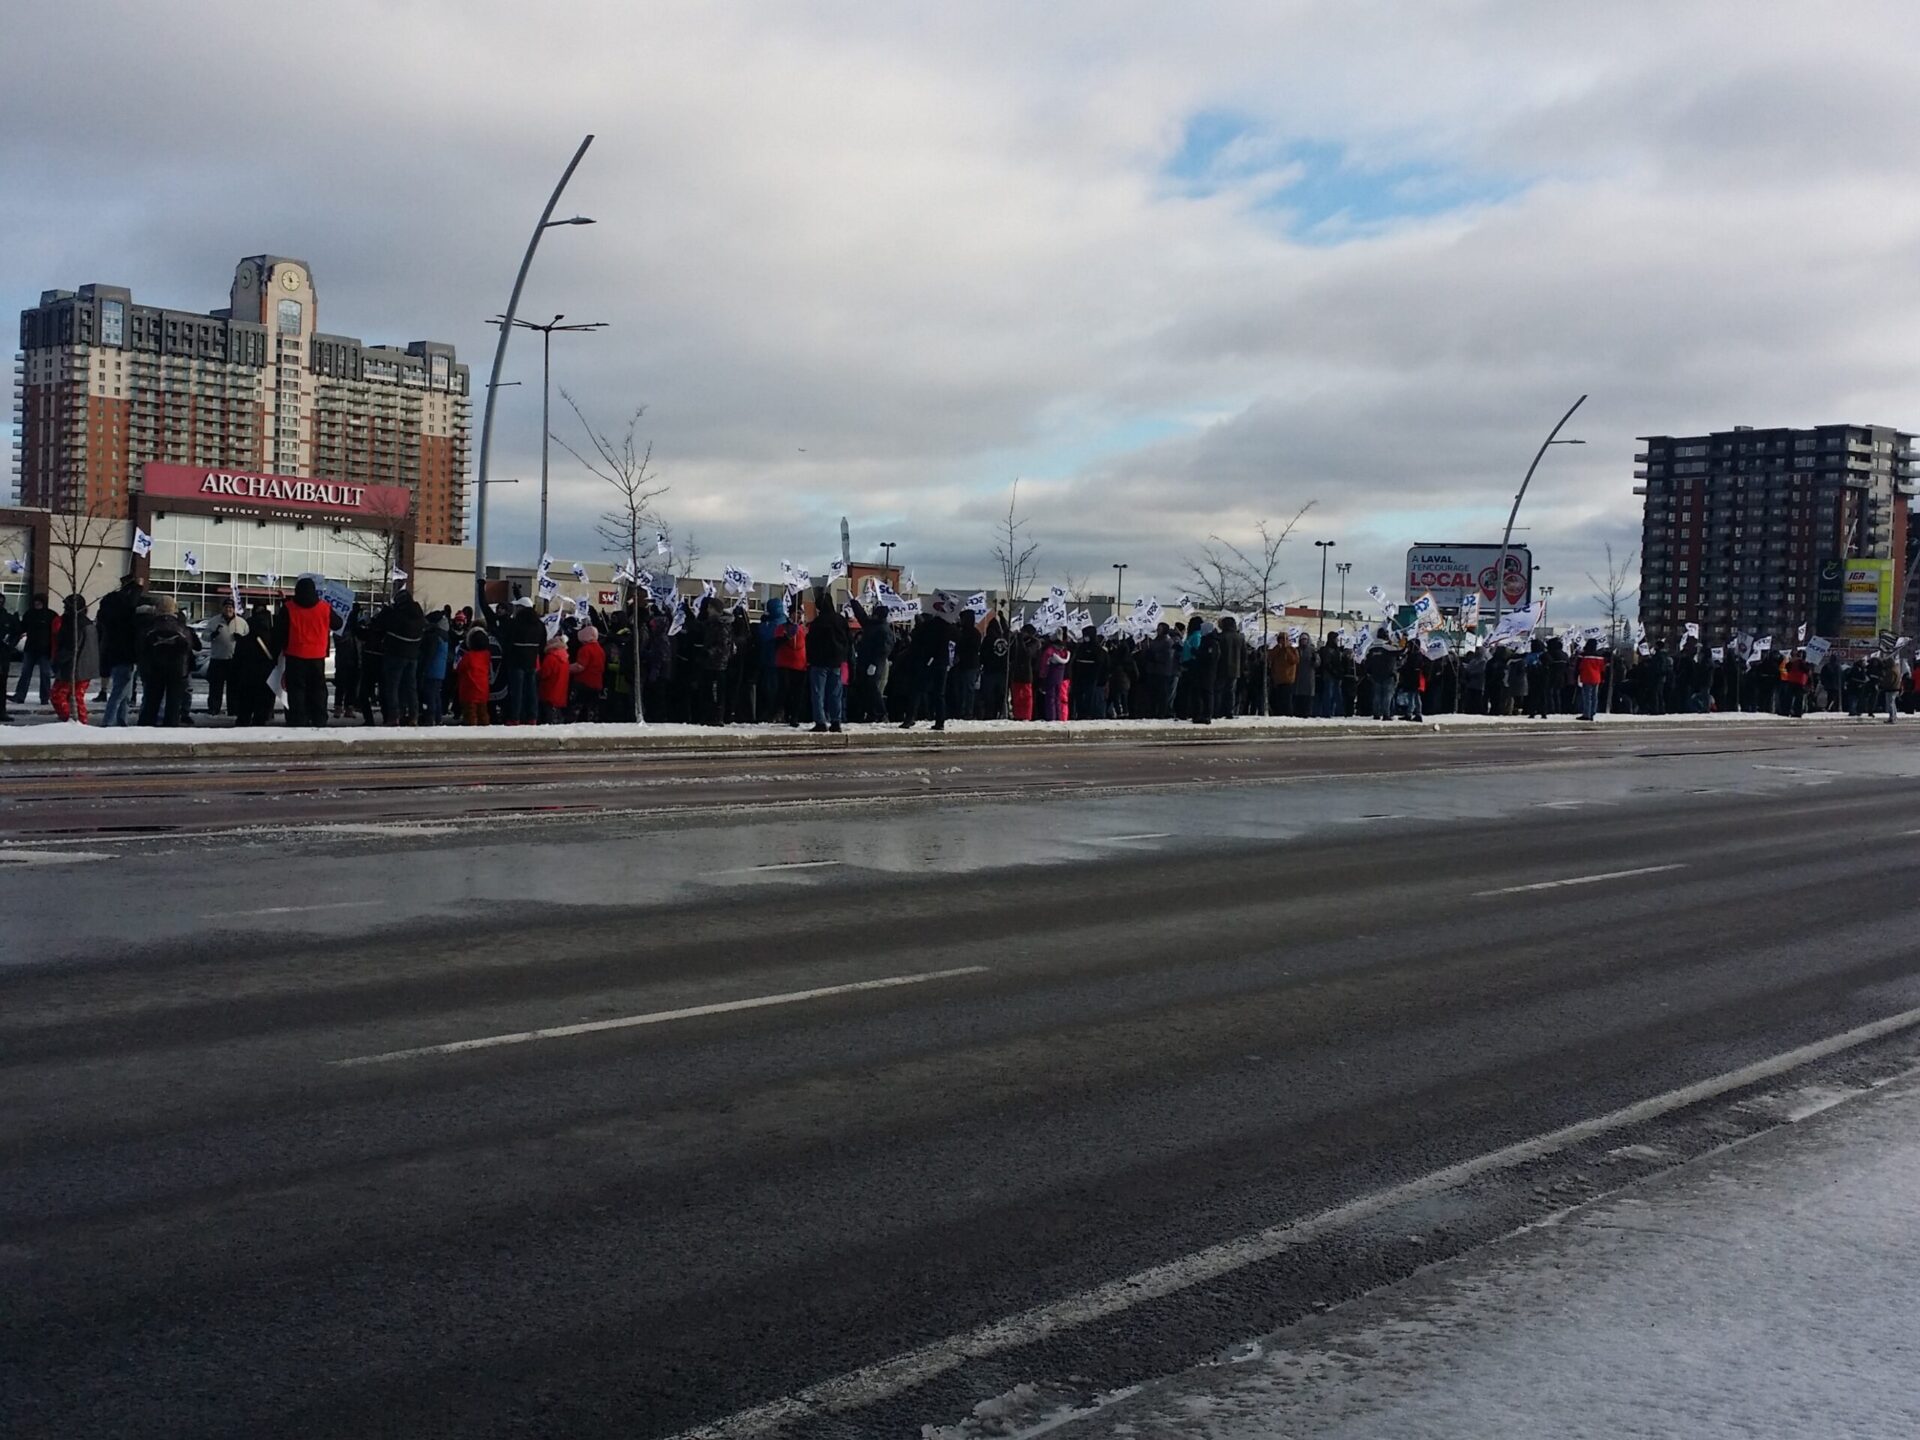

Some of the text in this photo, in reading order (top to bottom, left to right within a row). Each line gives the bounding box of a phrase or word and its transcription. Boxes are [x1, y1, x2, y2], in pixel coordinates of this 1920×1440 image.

[201, 473, 365, 506] ARCHAMBAULT
[213, 506, 260, 516] musique
[1411, 572, 1476, 586] LOCAL
